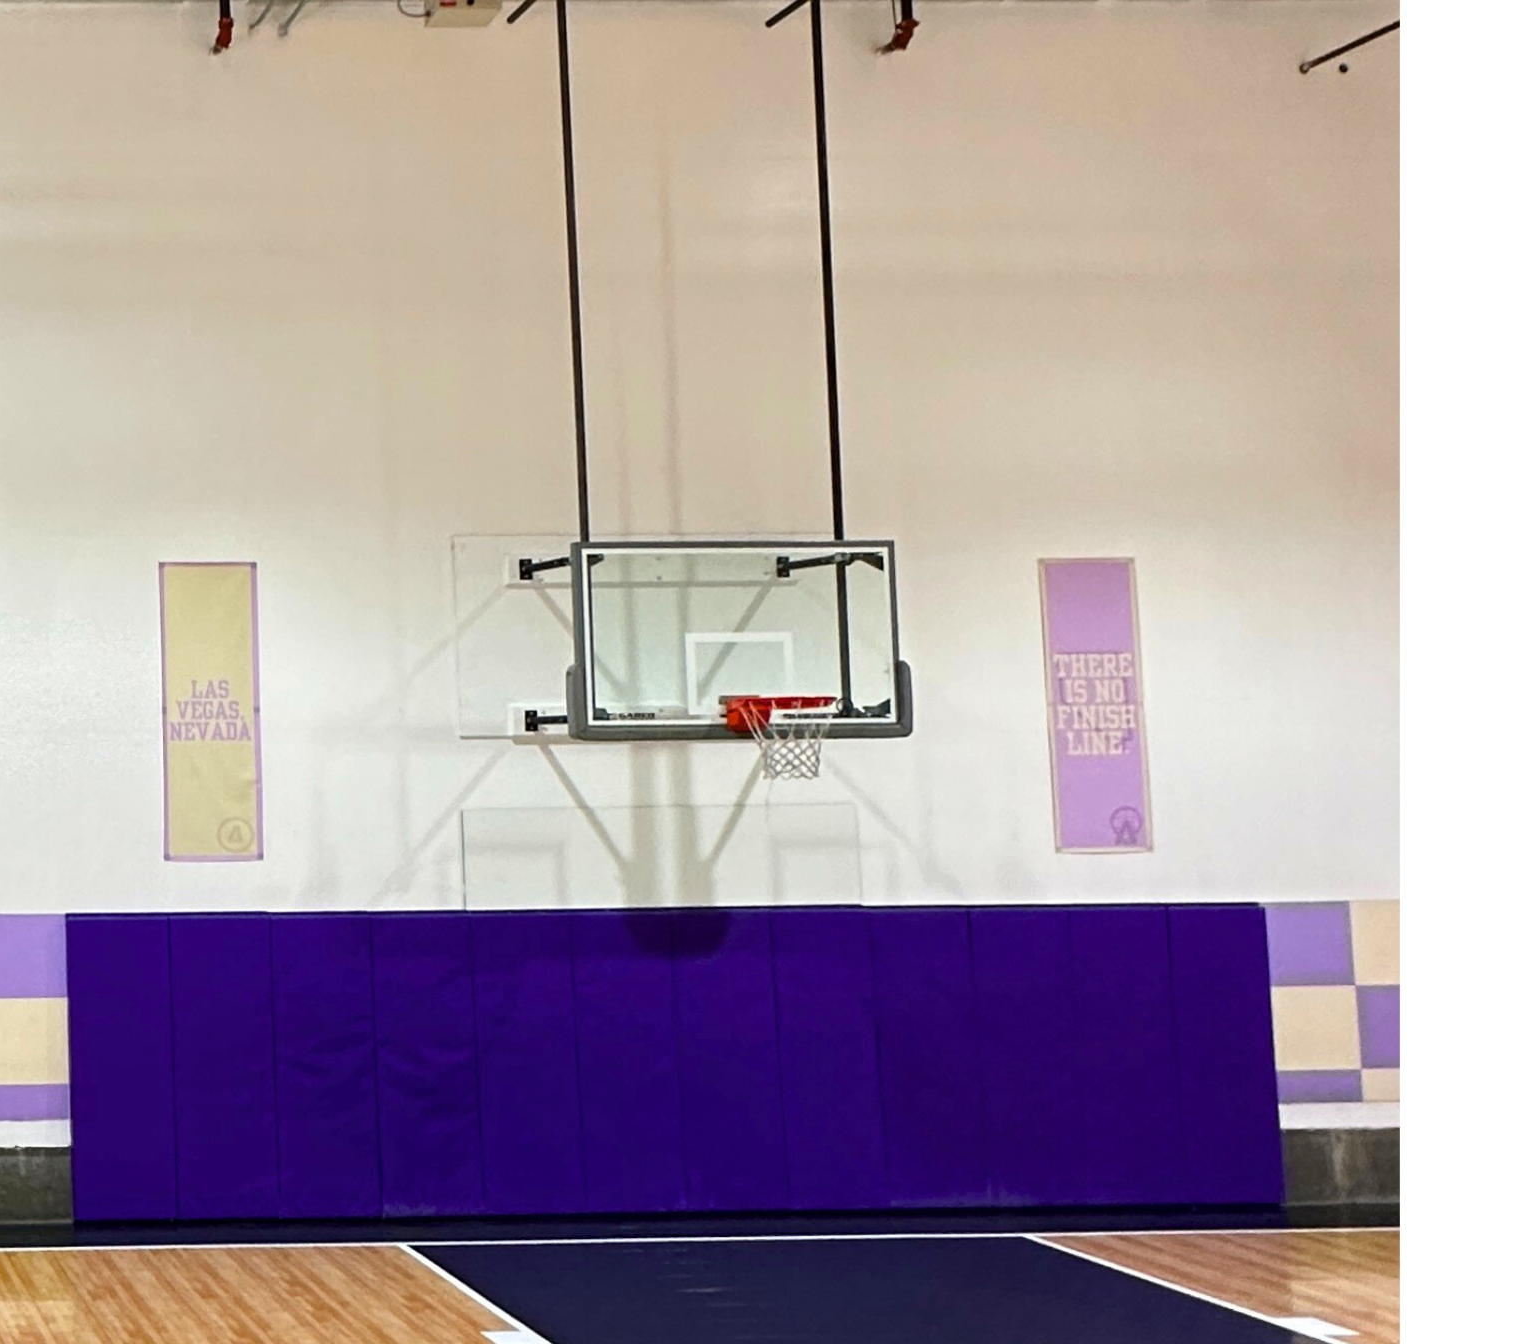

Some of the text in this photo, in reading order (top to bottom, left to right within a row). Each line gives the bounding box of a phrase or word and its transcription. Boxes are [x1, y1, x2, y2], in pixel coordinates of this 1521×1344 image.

[1053, 653, 1133, 677] THERE
[190, 679, 230, 699] LAS
[1065, 679, 1126, 703] IS NO
[175, 700, 245, 722] VEGAS,
[1057, 705, 1136, 730] FINISH
[169, 721, 253, 742] NEVADA
